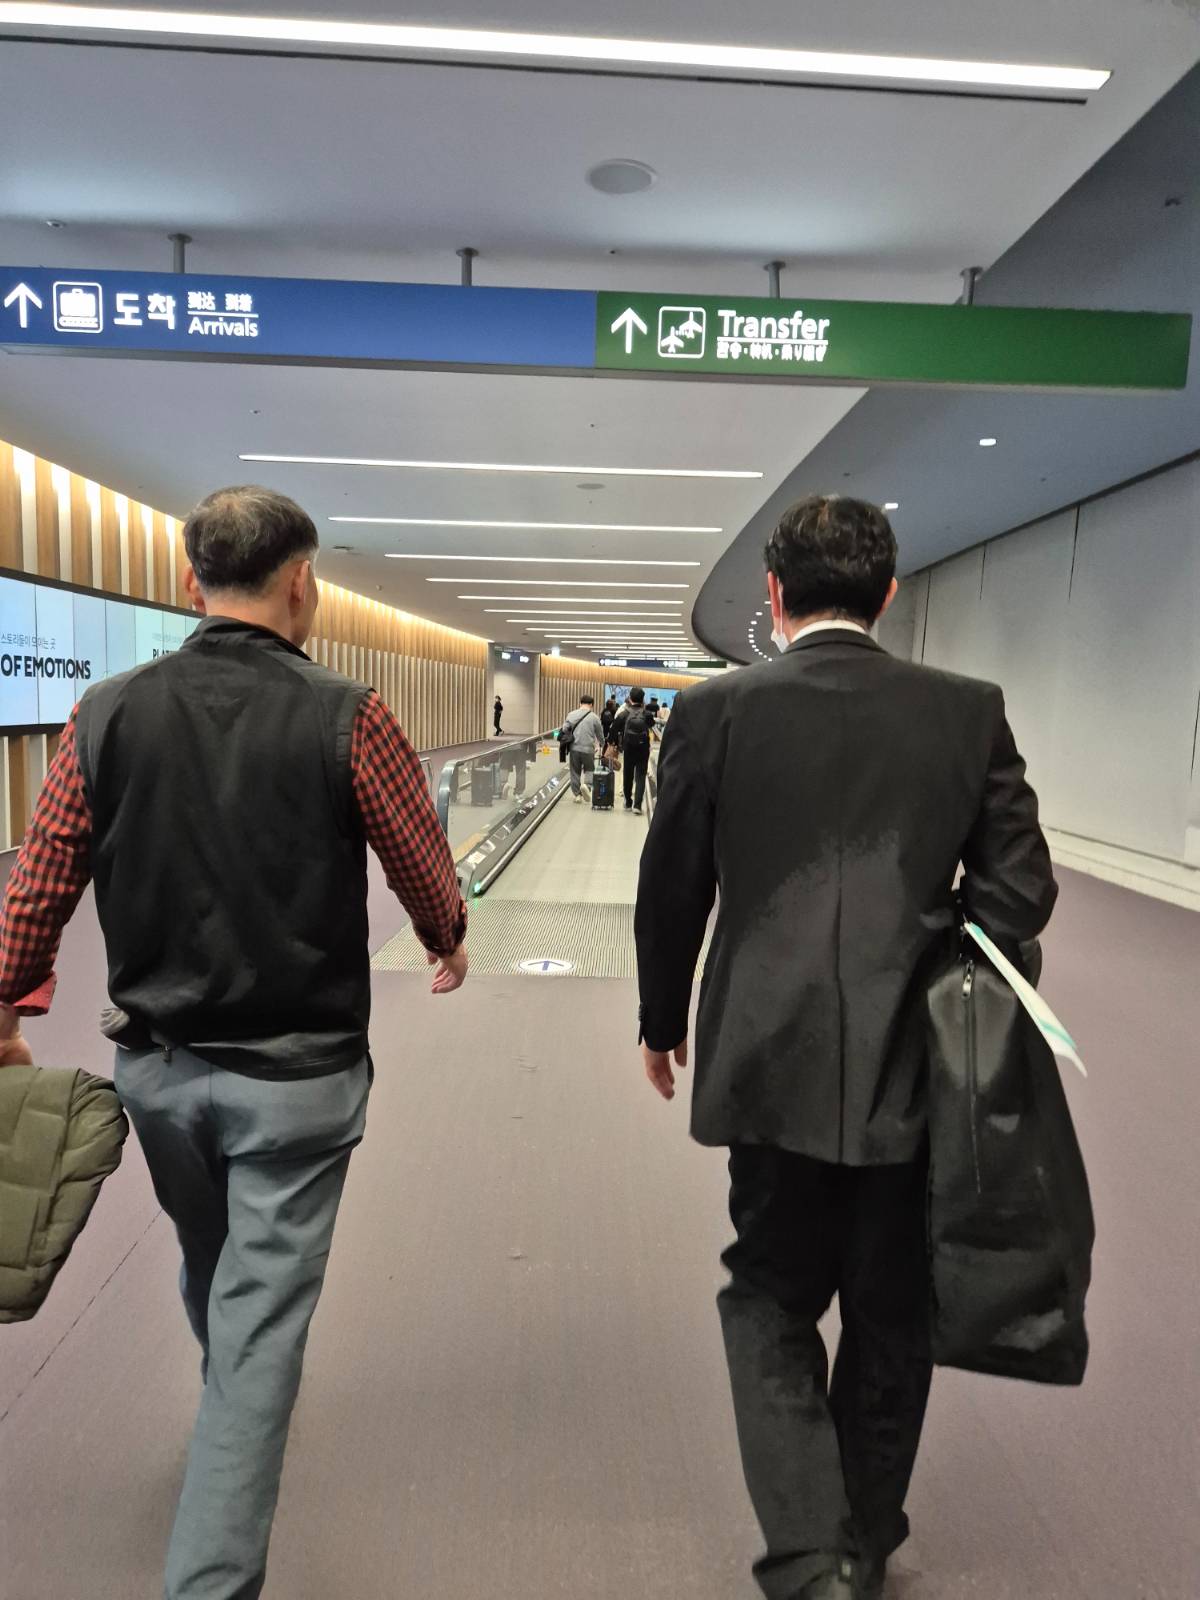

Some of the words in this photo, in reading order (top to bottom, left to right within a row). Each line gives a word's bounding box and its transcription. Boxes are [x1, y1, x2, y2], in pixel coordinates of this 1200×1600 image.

[113, 292, 176, 330] 도착
[717, 309, 830, 340] Transfer
[188, 316, 259, 338] Arrivals
[1, 653, 22, 677] OF
[24, 655, 91, 680] EMOTIONS
